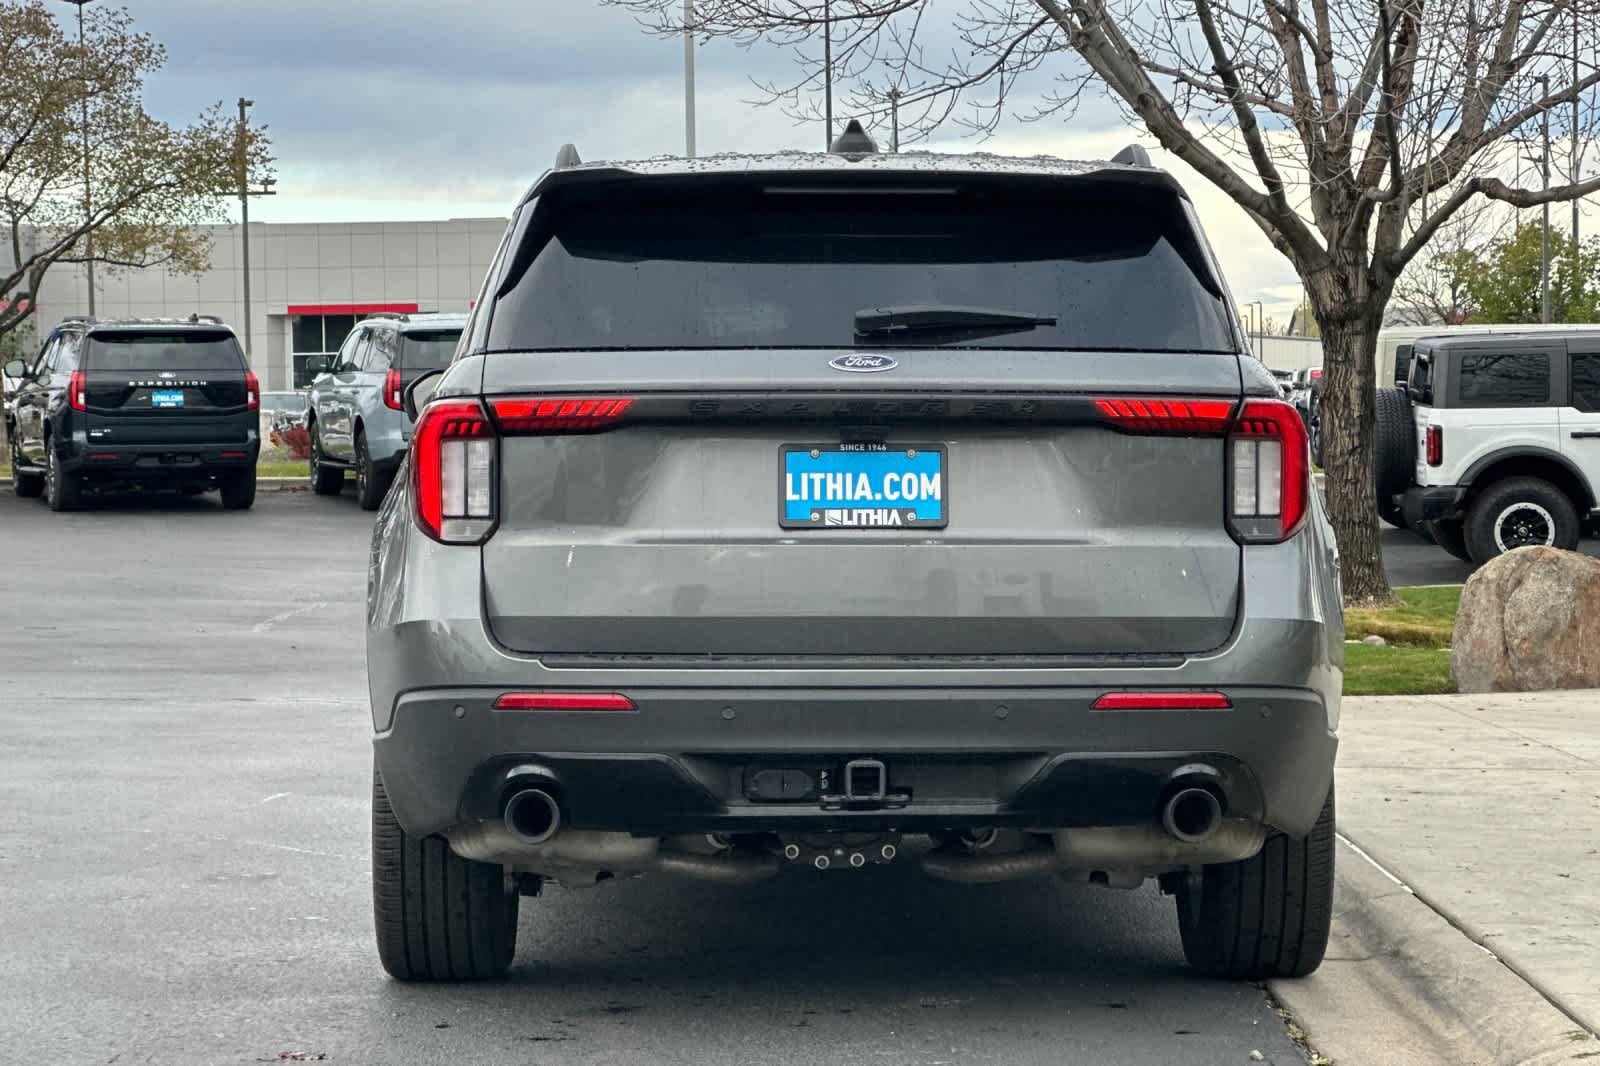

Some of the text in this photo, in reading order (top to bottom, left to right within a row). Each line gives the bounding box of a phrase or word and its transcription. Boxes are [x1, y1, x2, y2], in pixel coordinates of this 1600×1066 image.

[845, 355, 882, 367] Ford
[840, 443, 887, 451] SINCE 1946
[786, 472, 941, 501] LITHIA.COM
[843, 509, 902, 525] LITHIA
